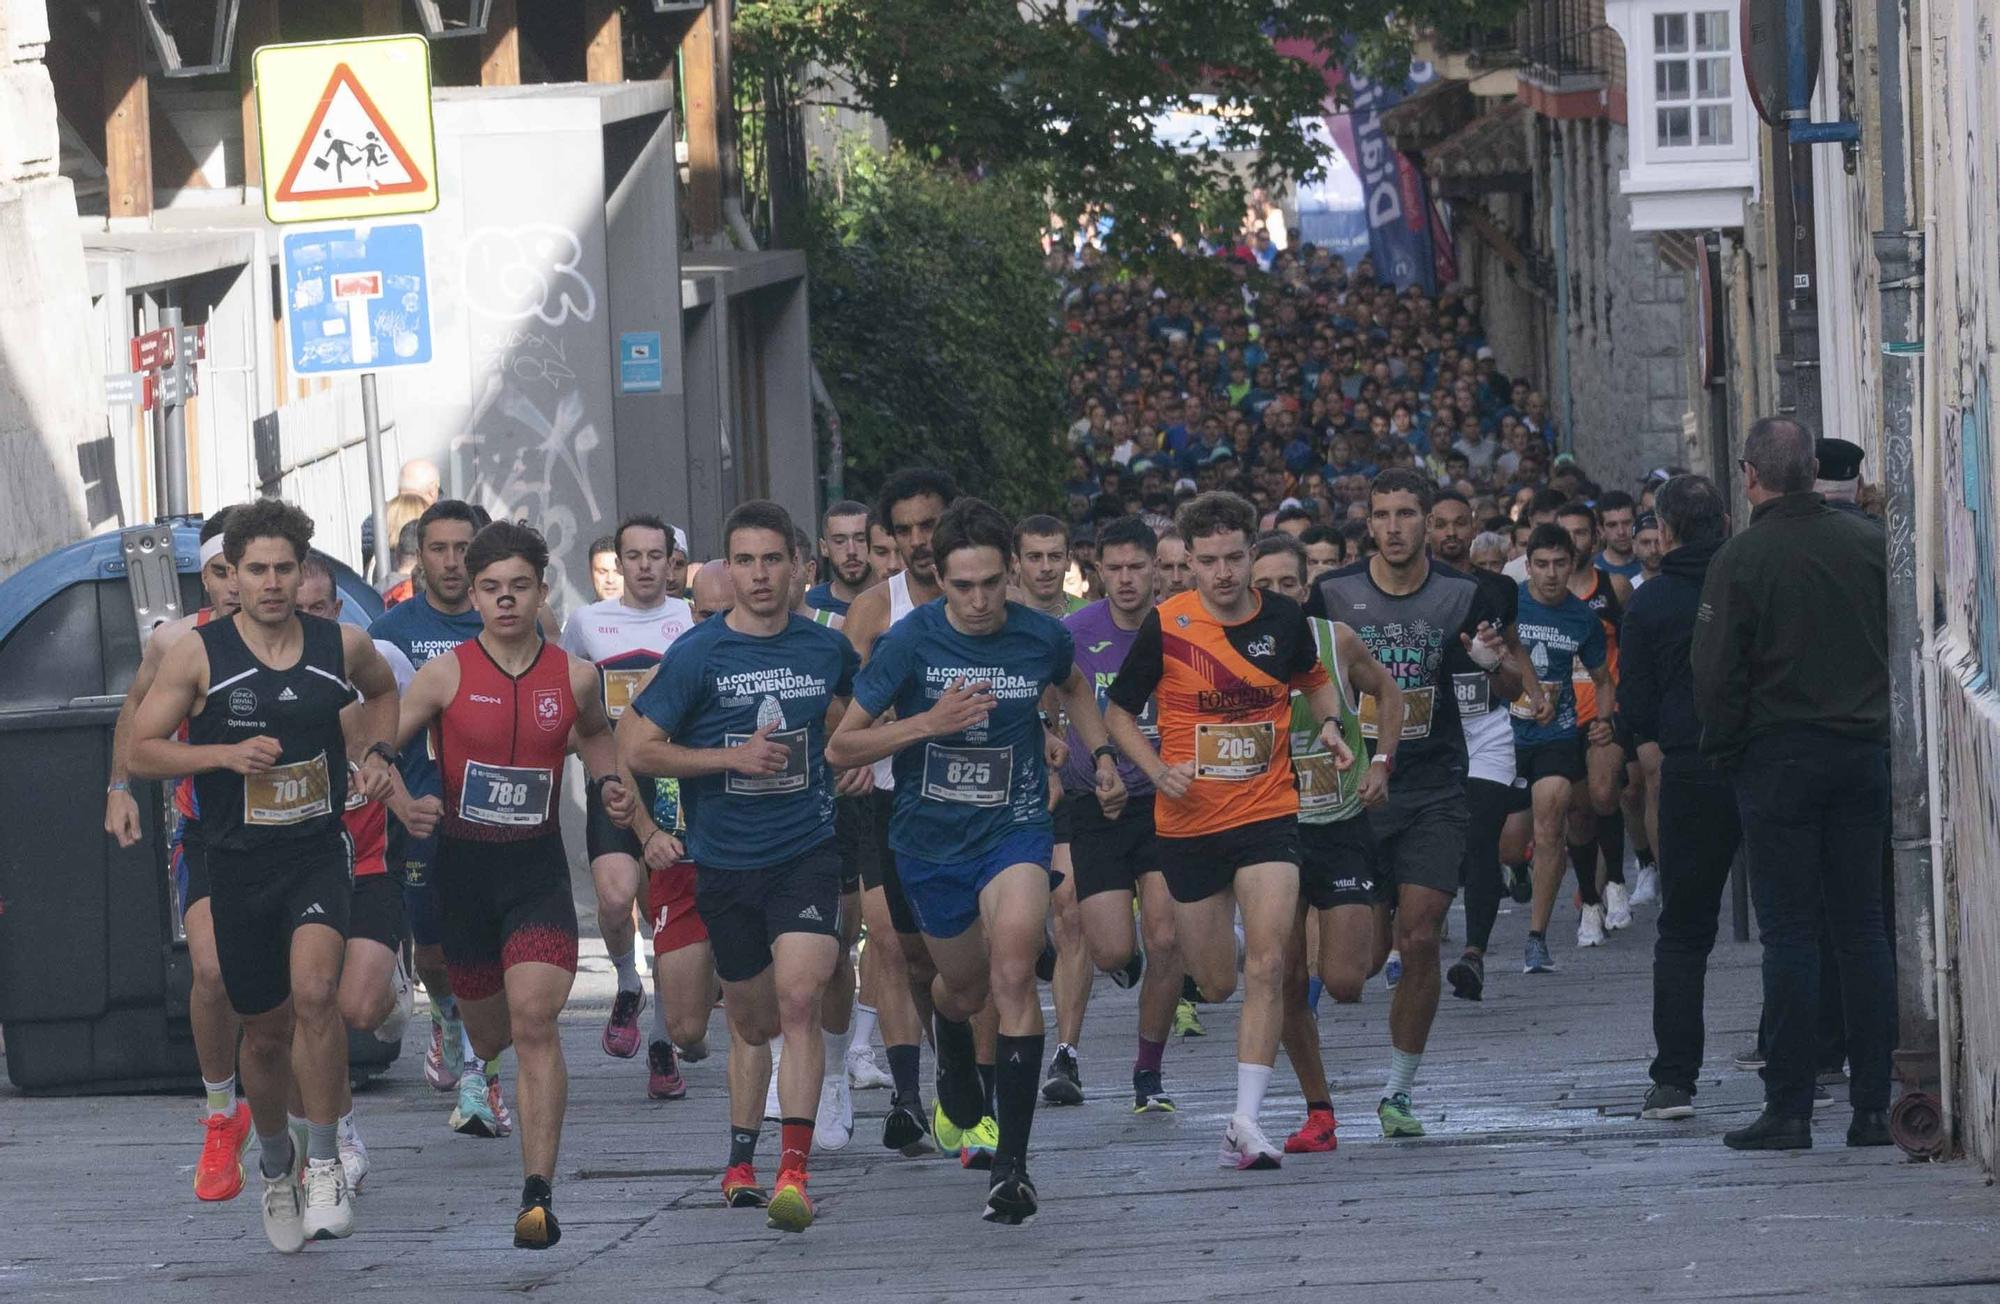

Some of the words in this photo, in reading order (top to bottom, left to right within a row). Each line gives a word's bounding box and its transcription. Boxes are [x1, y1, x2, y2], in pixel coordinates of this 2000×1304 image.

[411, 640, 423, 648] LA
[1520, 630, 1571, 644] ALMENDRA
[716, 676, 730, 686] LA
[731, 667, 793, 685] CONQUISTA
[926, 666, 940, 676] LA
[941, 667, 1006, 678] CONQUISTA
[736, 674, 814, 696] ALMENDRA
[780, 686, 826, 700] KONKISTA
[1217, 737, 1256, 760] 205
[946, 761, 991, 784] 825
[272, 775, 307, 804] 701
[487, 781, 528, 806] 788
